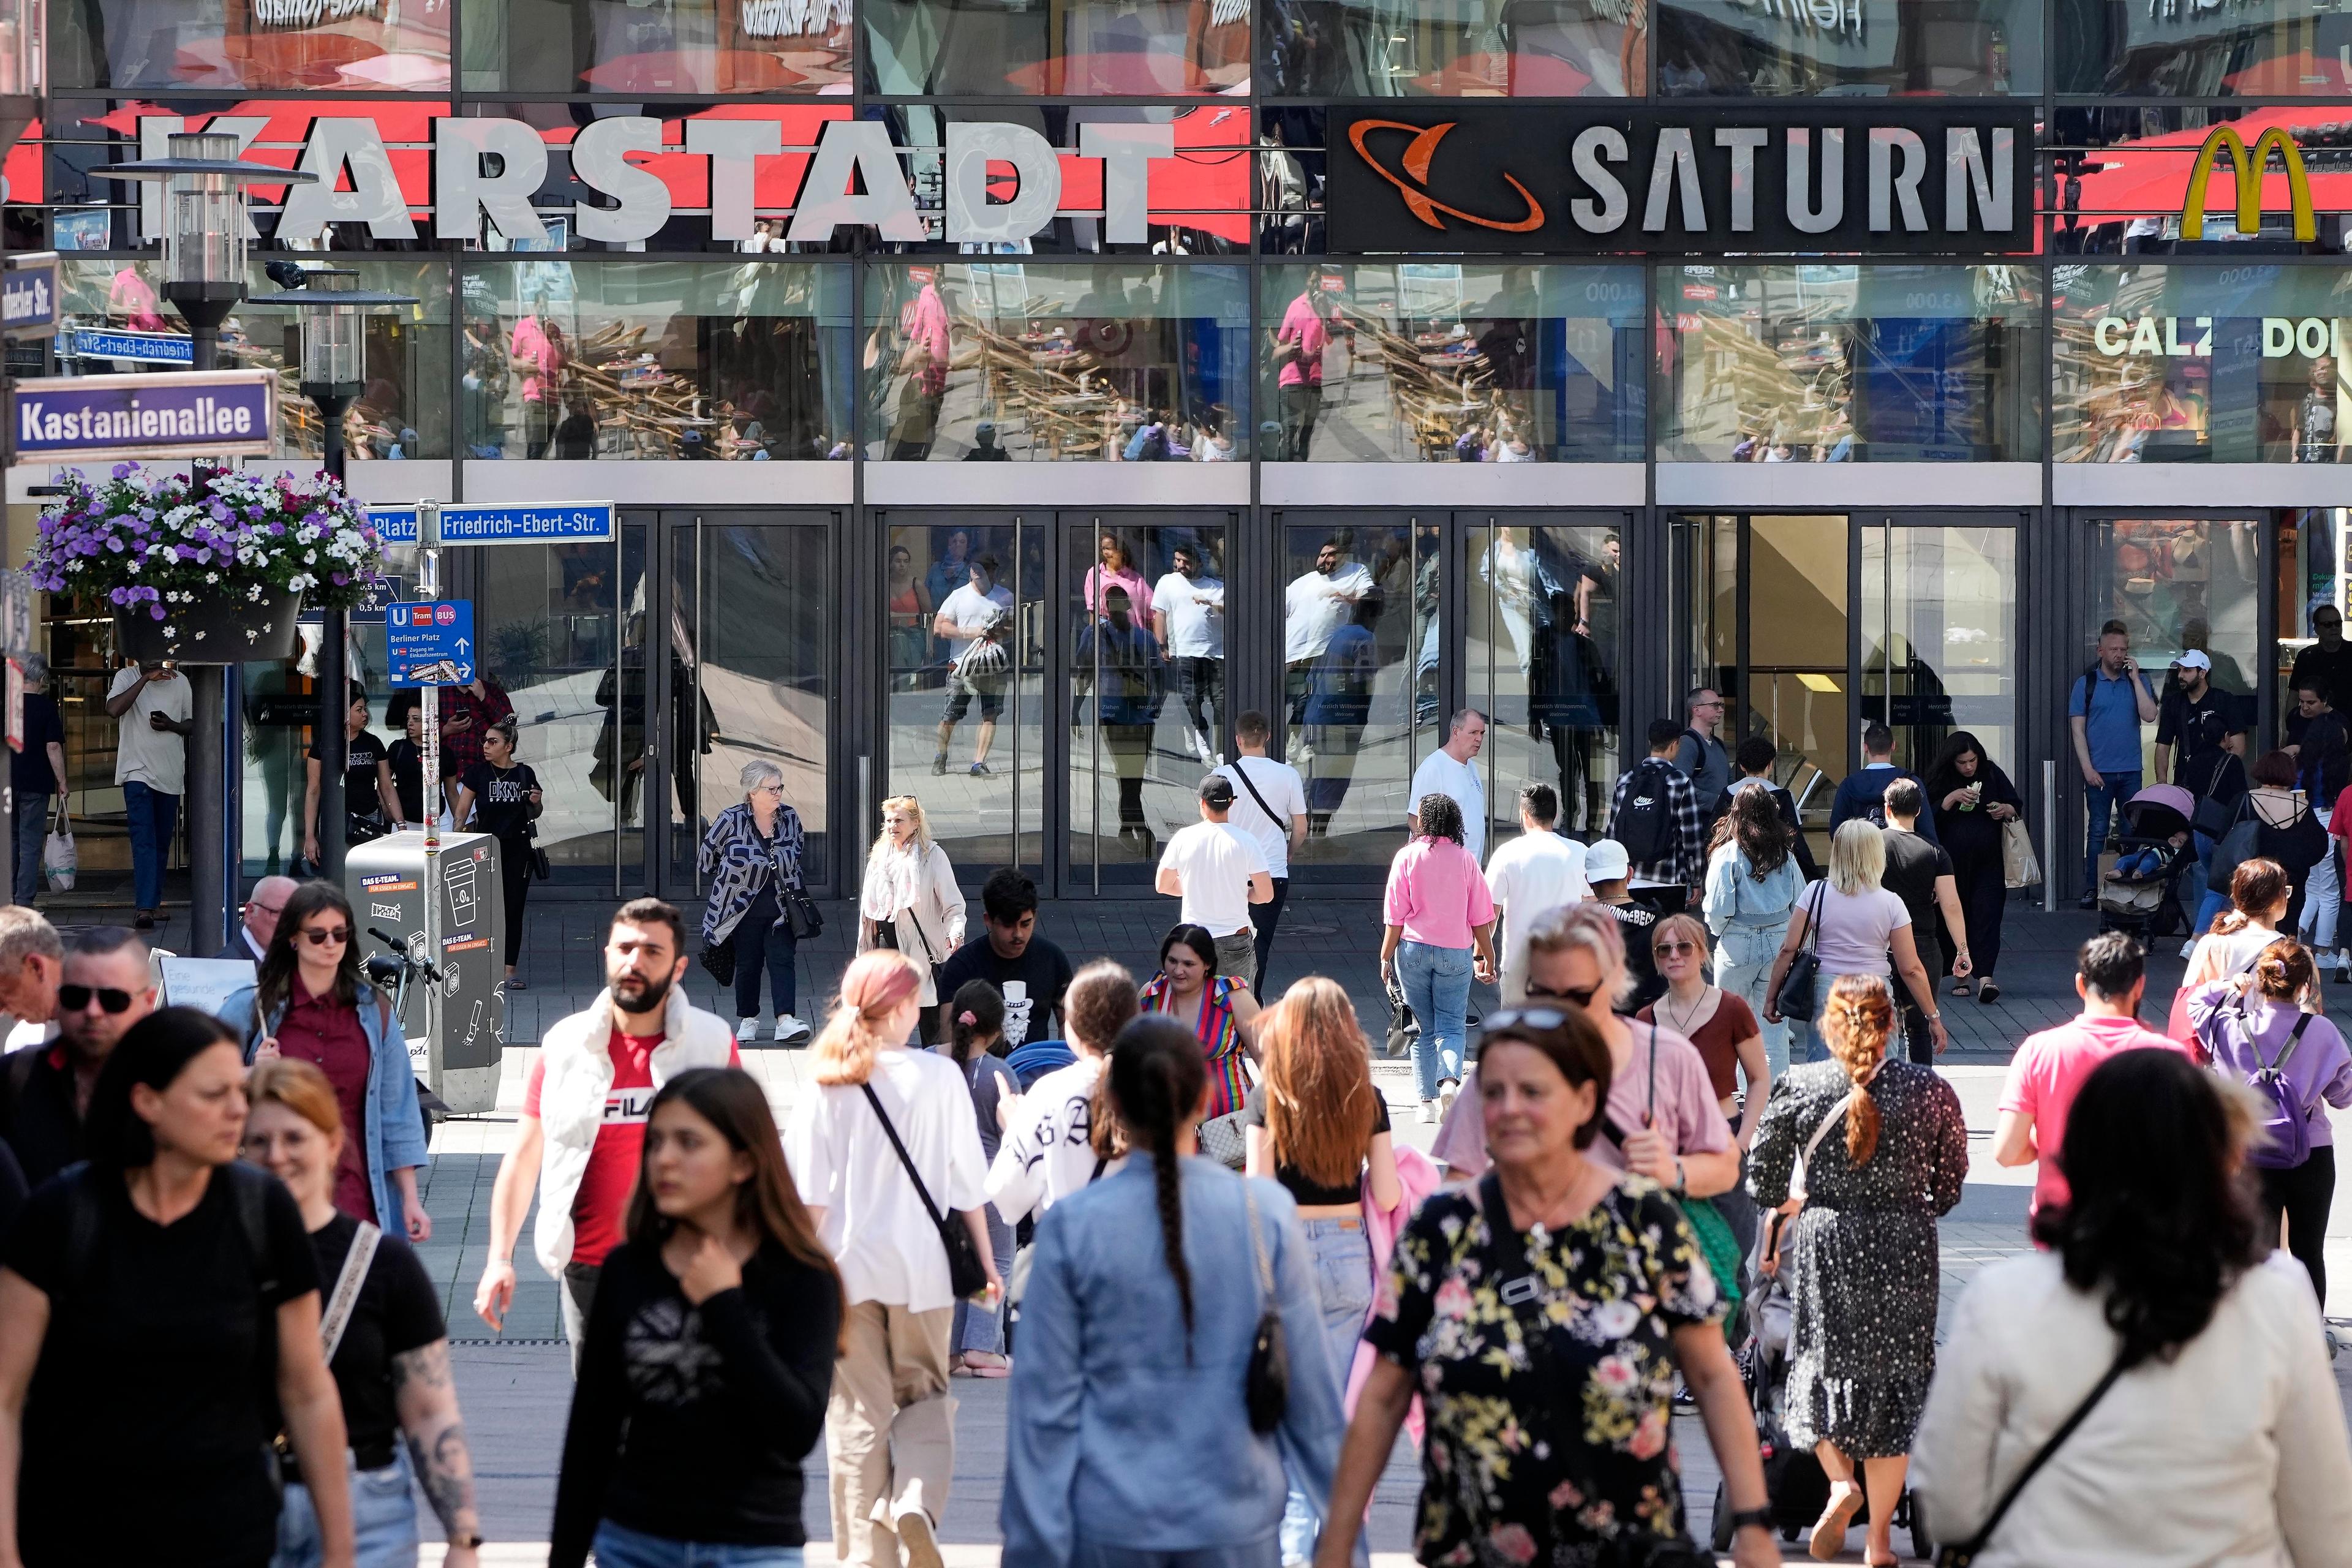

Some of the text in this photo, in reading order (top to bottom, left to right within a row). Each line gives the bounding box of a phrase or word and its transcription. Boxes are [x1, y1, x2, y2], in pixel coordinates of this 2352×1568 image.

[140, 116, 1175, 244] KARSTADT
[1570, 126, 2014, 234] SATURN
[34, 277, 51, 315] Str.
[21, 397, 251, 441] Kastanienallee
[375, 518, 417, 537] Platz
[443, 513, 600, 535] Friedrich-Ebert-Str.
[359, 604, 372, 612] 0,5
[392, 608, 407, 626] U
[437, 611, 454, 620] BUS
[391, 635, 420, 643] Berliner
[489, 781, 521, 798] DKNY
[1637, 796, 1653, 804] NIKE
[375, 875, 399, 884] E-TEAM.
[453, 933, 473, 943] E-TEAM.
[170, 984, 214, 995] gesunde
